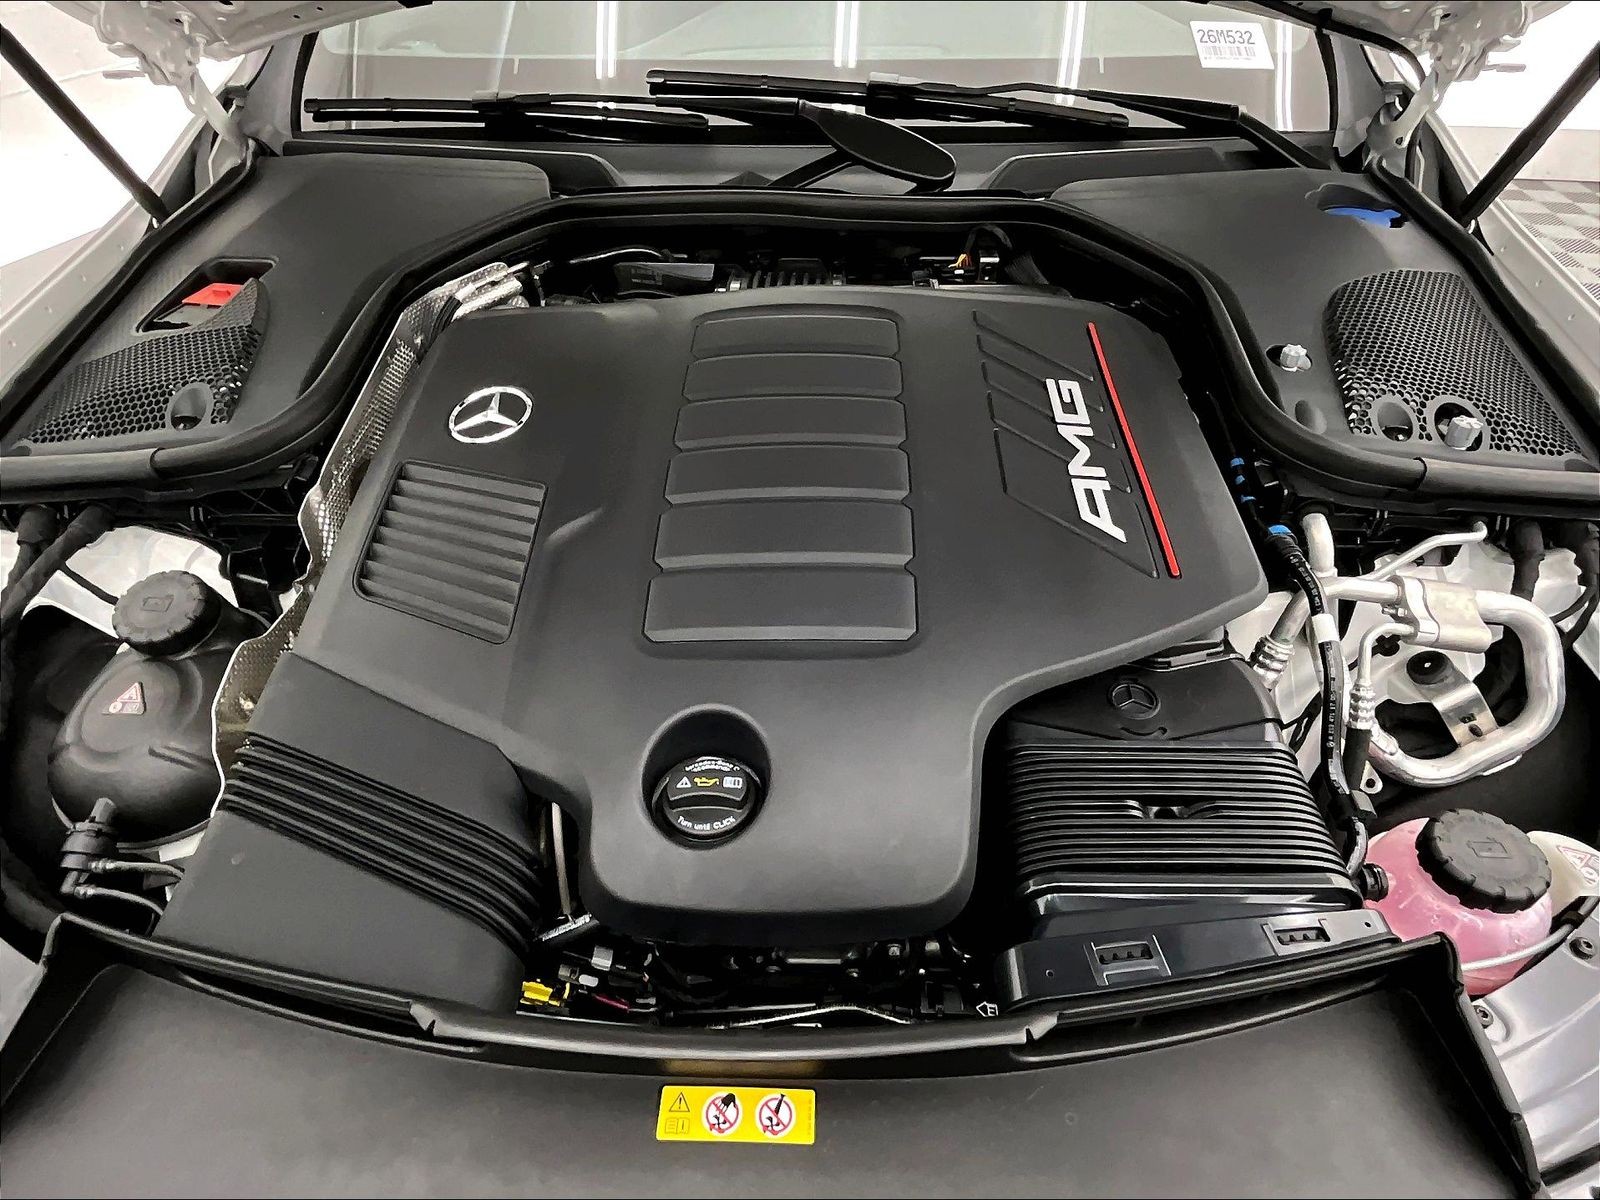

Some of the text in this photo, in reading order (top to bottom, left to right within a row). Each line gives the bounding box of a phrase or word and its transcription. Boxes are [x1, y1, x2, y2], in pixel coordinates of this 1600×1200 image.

[1196, 29, 1256, 45] 26M532
[1045, 378, 1127, 543] AMG
[677, 816, 736, 831] Turn until CLICK
